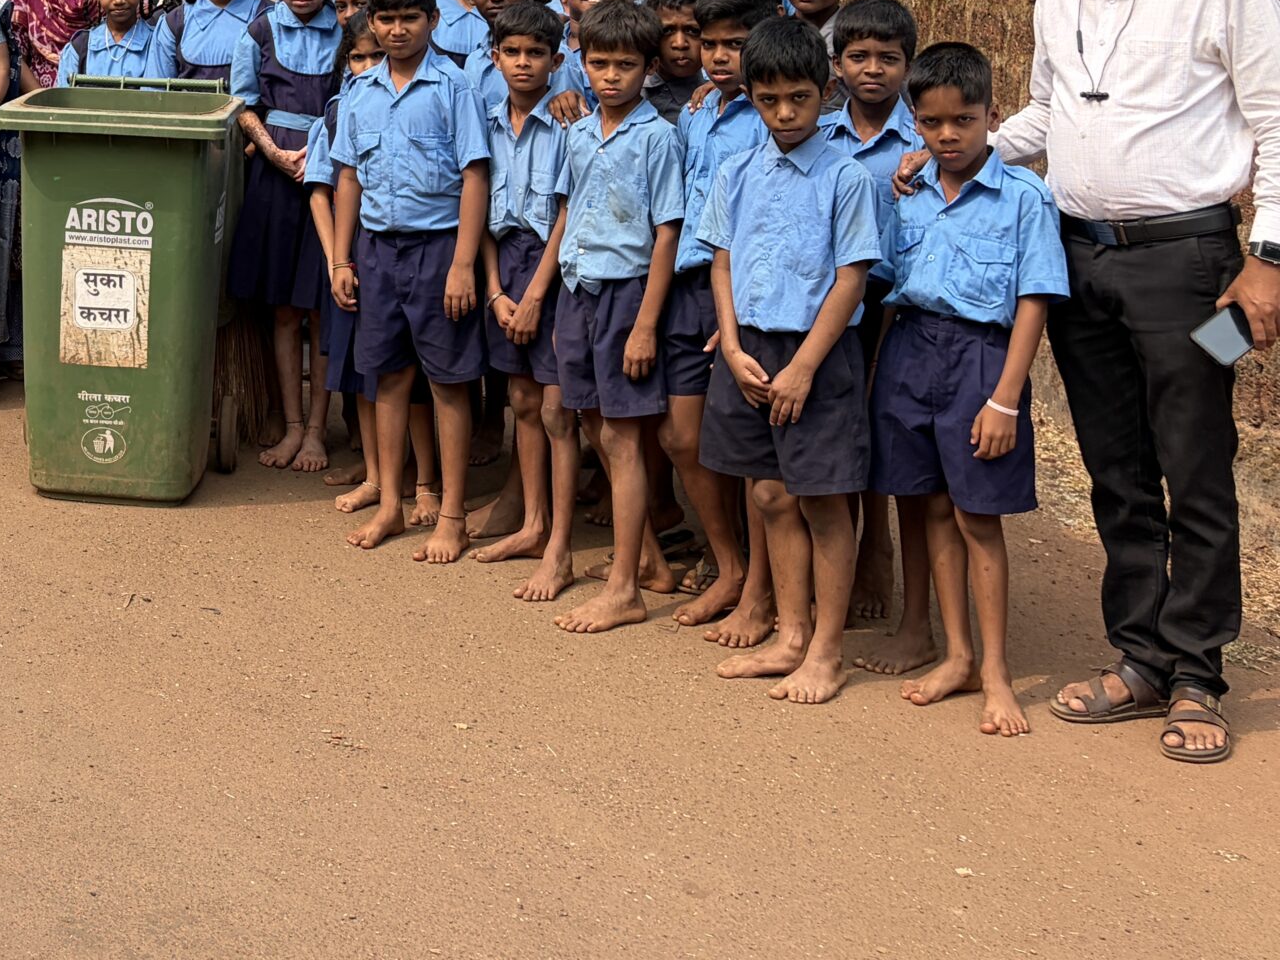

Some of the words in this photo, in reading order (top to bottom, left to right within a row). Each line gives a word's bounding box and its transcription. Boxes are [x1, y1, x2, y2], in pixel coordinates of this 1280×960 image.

[65, 207, 154, 234] ARISTO
[68, 234, 149, 246] www.aristoplast.com
[83, 272, 125, 296] सुका
[78, 306, 130, 324] कचरा
[77, 390, 102, 402] गीला
[104, 394, 131, 404] कचरा
